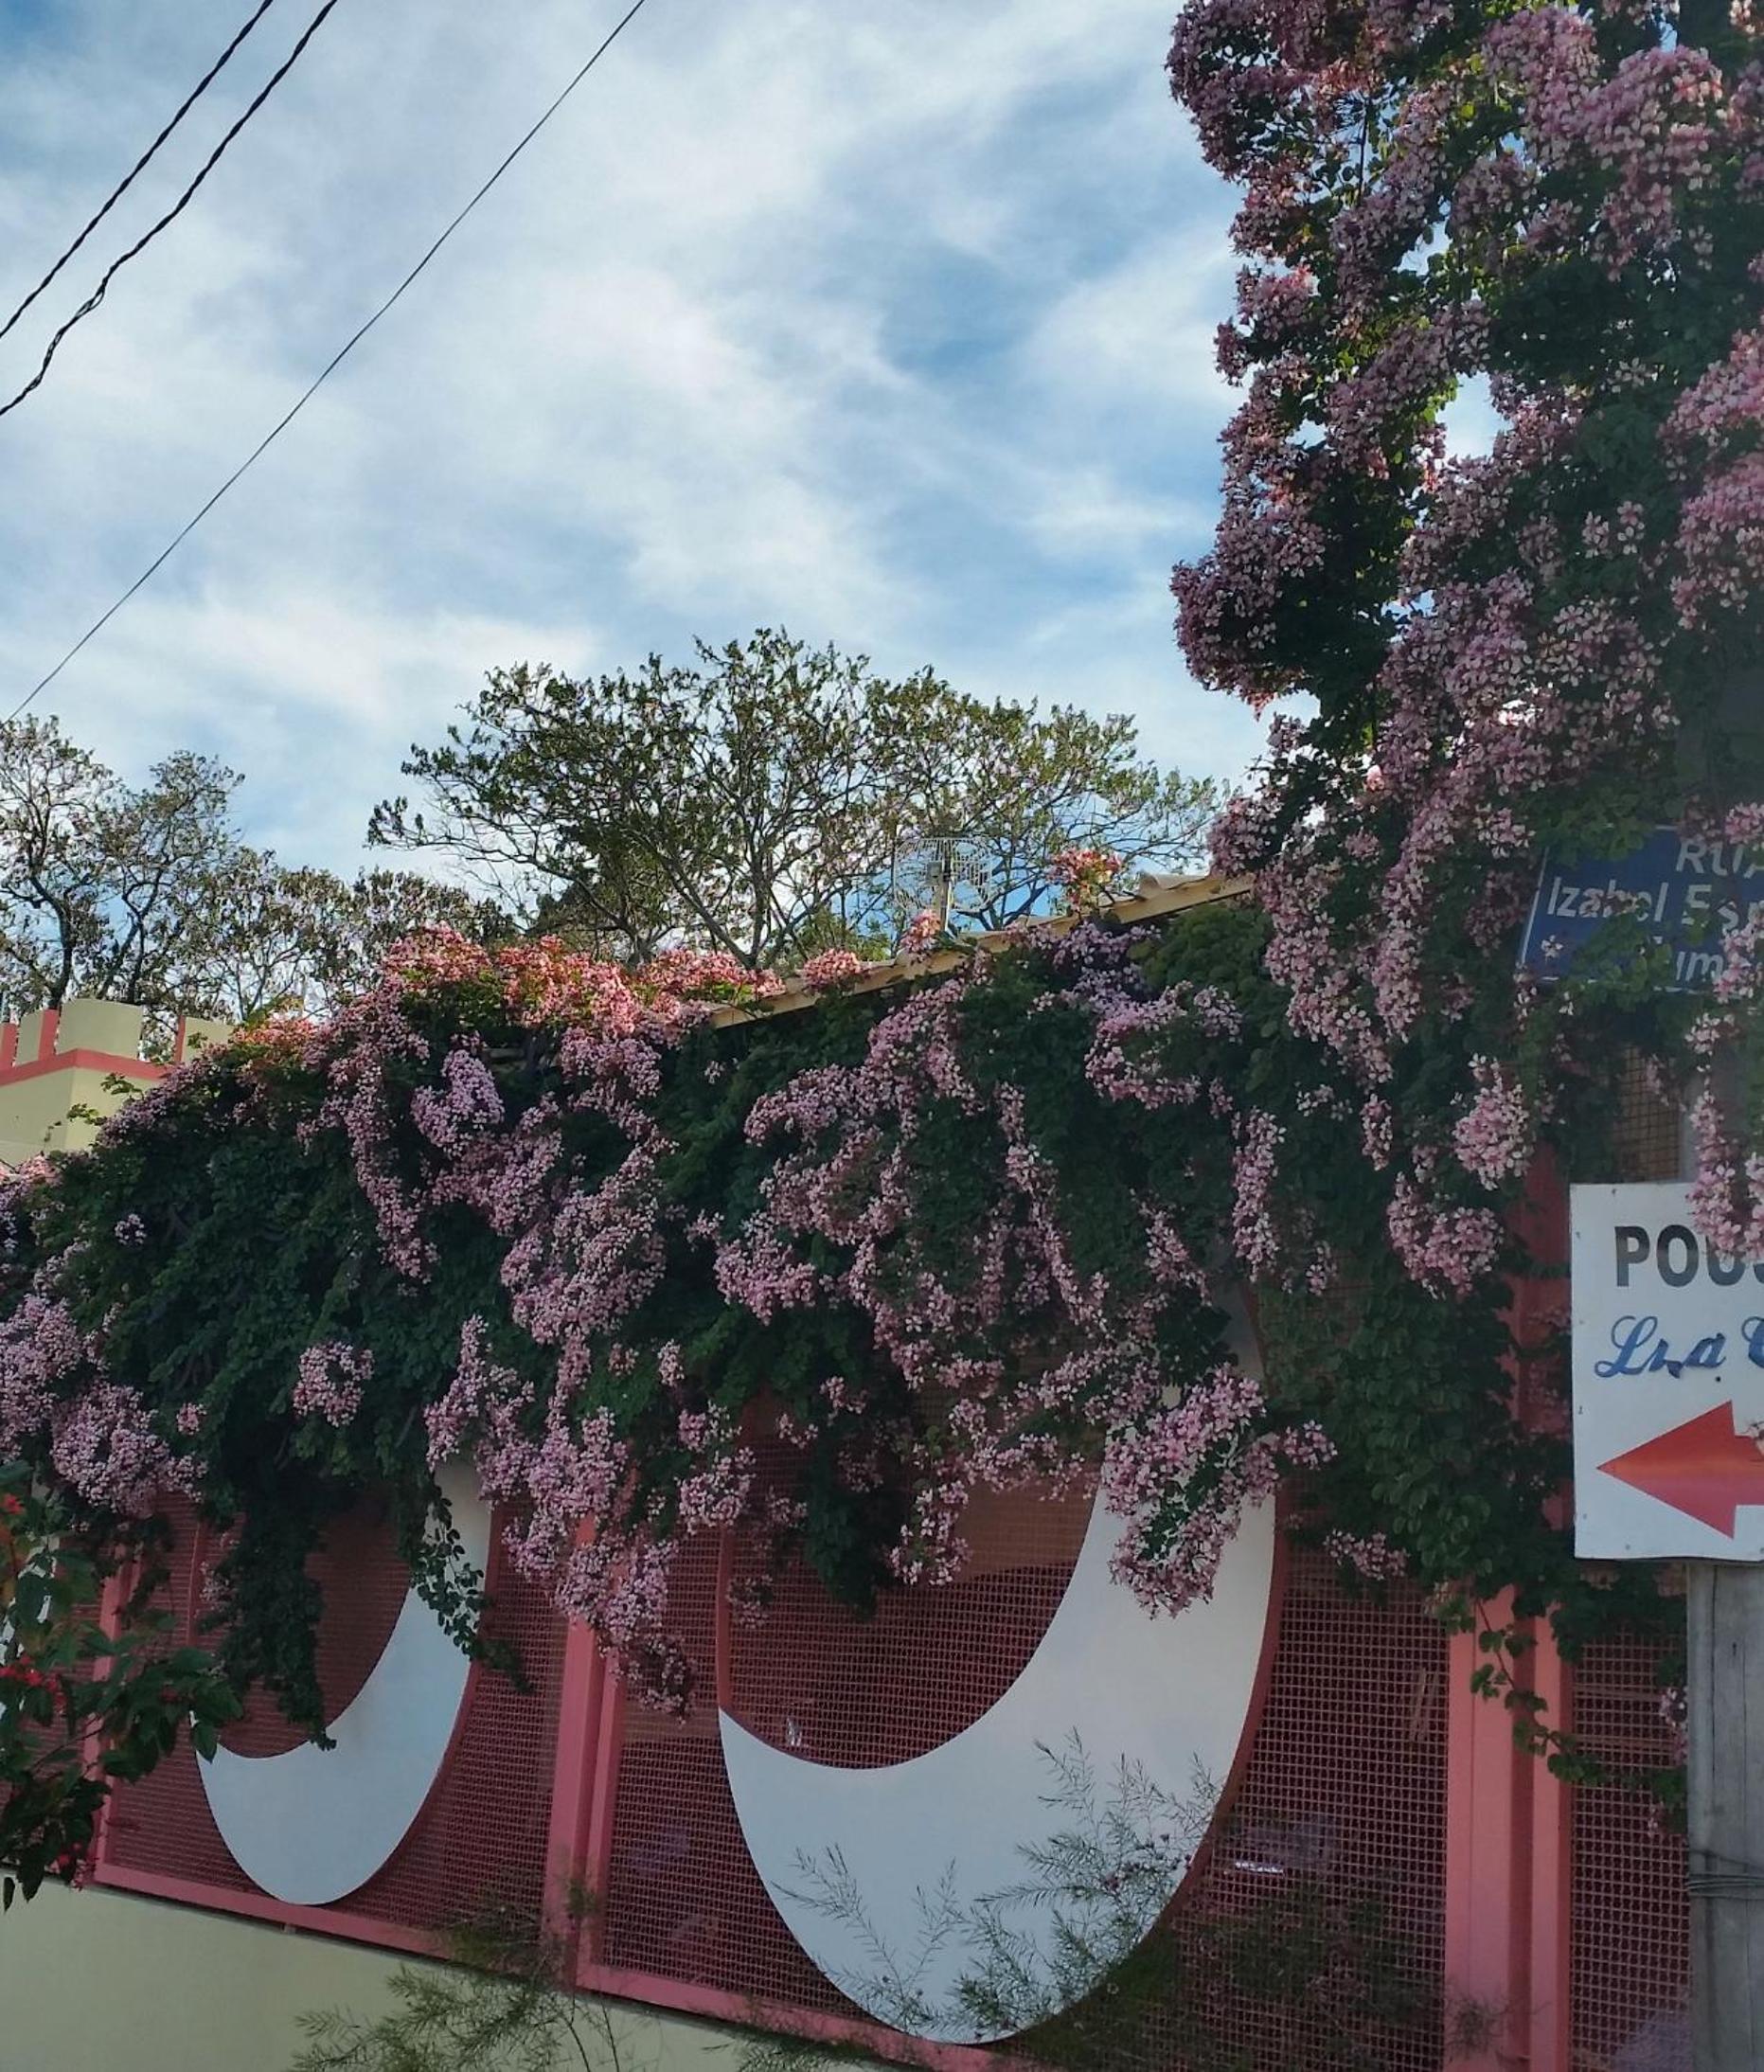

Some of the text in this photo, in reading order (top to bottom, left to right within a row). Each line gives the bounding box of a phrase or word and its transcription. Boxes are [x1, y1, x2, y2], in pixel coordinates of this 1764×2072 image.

[1675, 837, 1764, 879] RU
[1682, 884, 1764, 933] Es
[1613, 1223, 1764, 1289] POU
